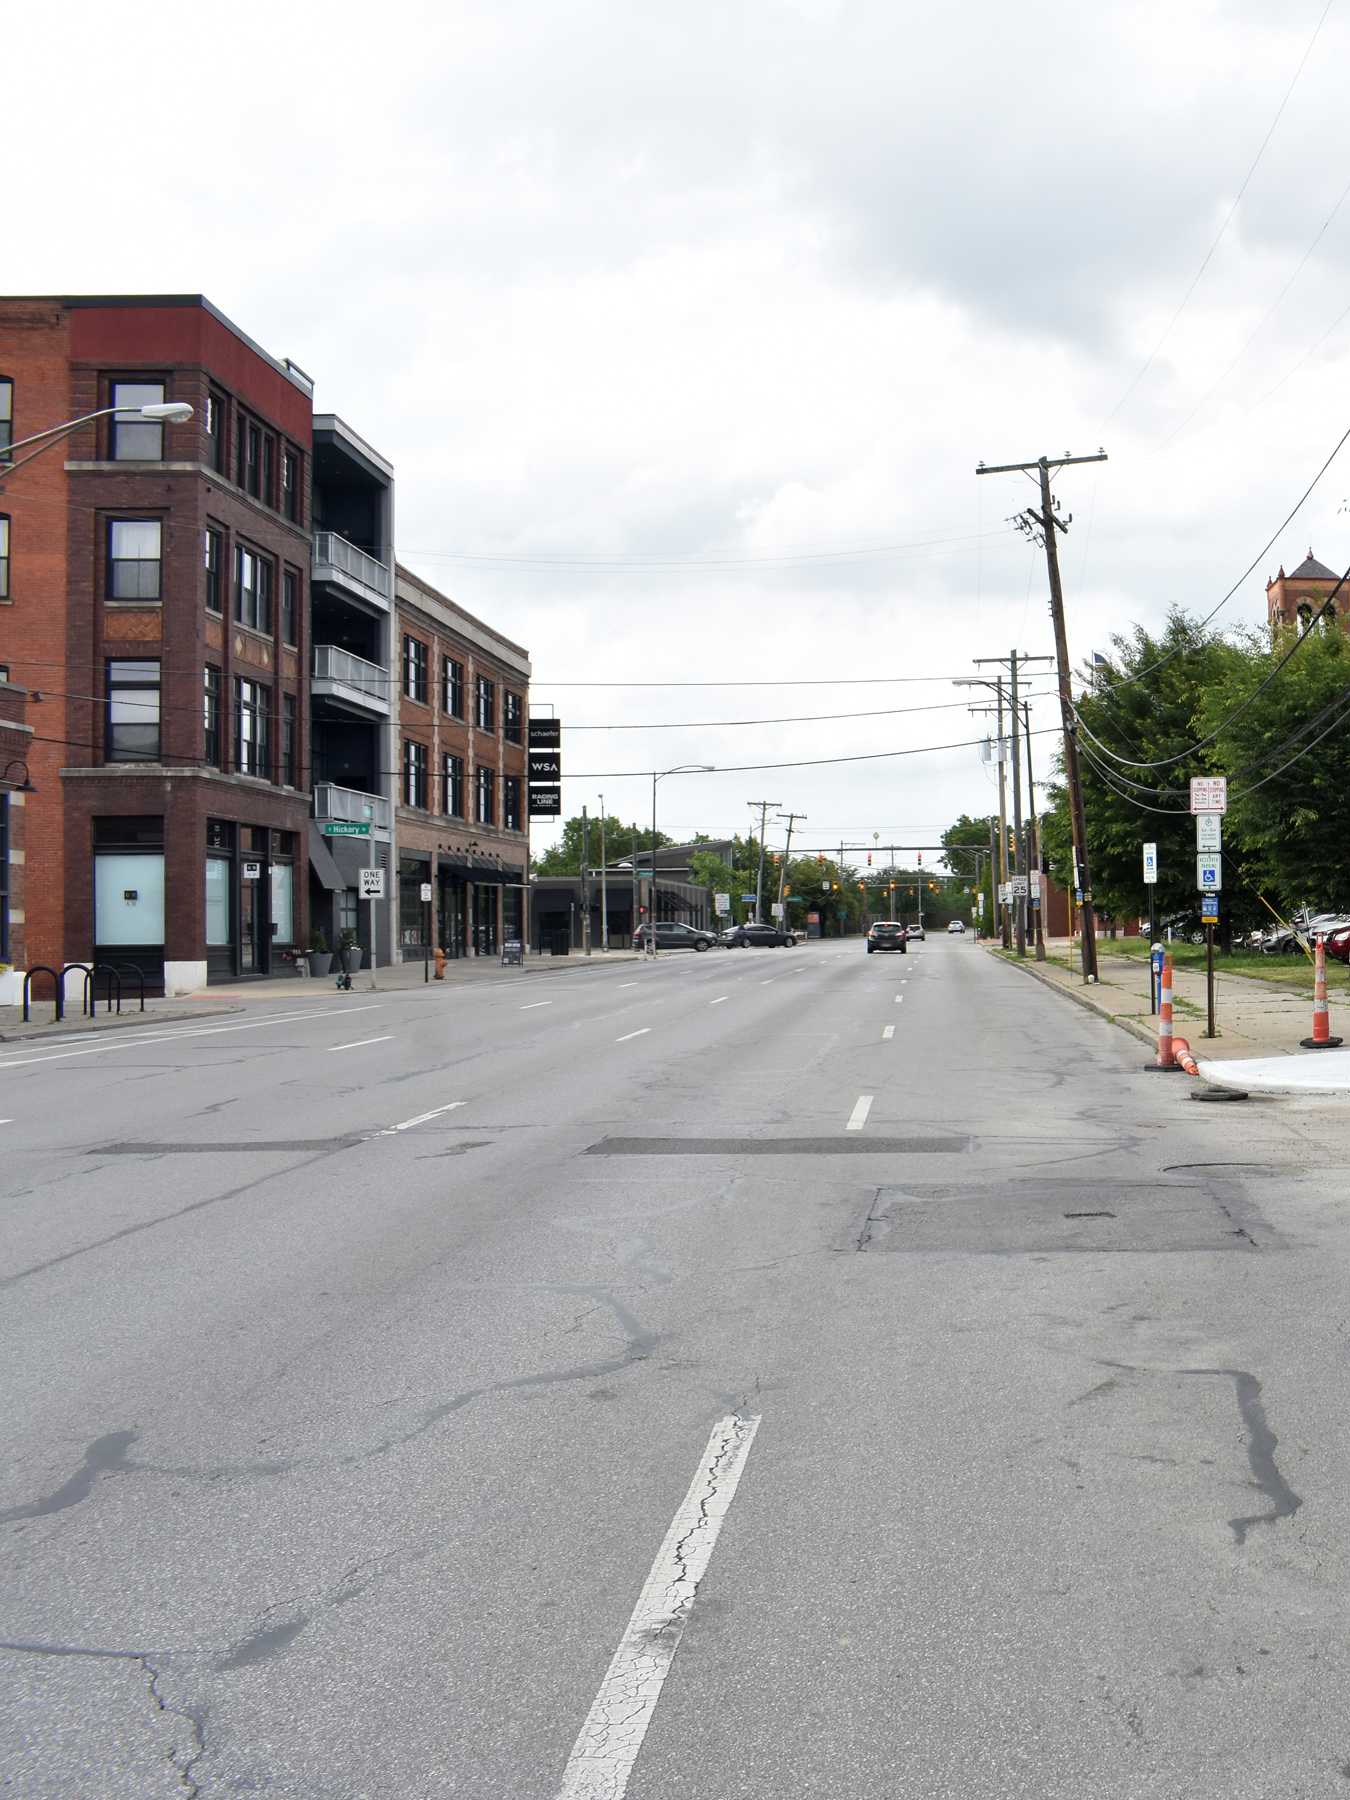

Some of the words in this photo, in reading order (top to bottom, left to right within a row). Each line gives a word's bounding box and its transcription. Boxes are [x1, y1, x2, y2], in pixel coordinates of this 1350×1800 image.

[531, 762, 558, 772] WSA
[363, 871, 381, 879] ONE
[1013, 886, 1026, 894] 25
